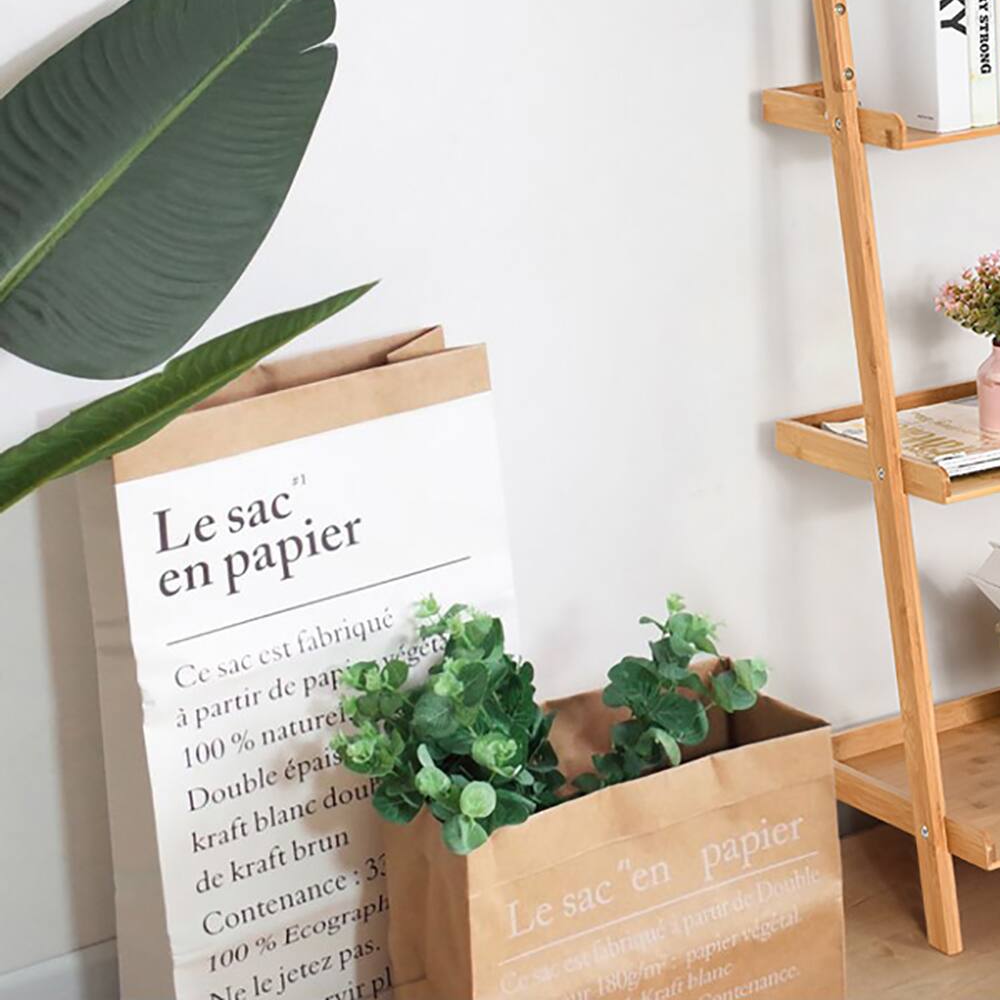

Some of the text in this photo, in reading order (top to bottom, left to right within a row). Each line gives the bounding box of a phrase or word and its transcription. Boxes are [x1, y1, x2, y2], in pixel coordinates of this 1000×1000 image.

[978, 14, 992, 75] STRONG
[153, 508, 218, 554] Le
[227, 491, 293, 534] sac
[159, 516, 362, 598] en papier
[174, 607, 394, 689] Ce sac est fabriqué
[176, 708, 188, 728] à
[195, 689, 262, 728] partir
[268, 677, 297, 701] de
[183, 738, 225, 769] 100
[231, 730, 255, 754] %
[187, 747, 342, 811] Double épais
[191, 816, 249, 853] kraft
[254, 799, 317, 833] blanc
[195, 830, 350, 894] de kraft brun
[505, 899, 553, 938] Le
[562, 881, 614, 917] sac
[700, 816, 803, 881] papier
[202, 874, 347, 936] Contenance
[682, 902, 729, 936] partir
[755, 866, 821, 902] Double
[208, 894, 390, 973] 100 % Ecograph
[685, 933, 739, 968] papier
[253, 976, 272, 996] le
[277, 956, 333, 995] jetez
[338, 939, 381, 971] pas.
[687, 963, 734, 990] blanc
